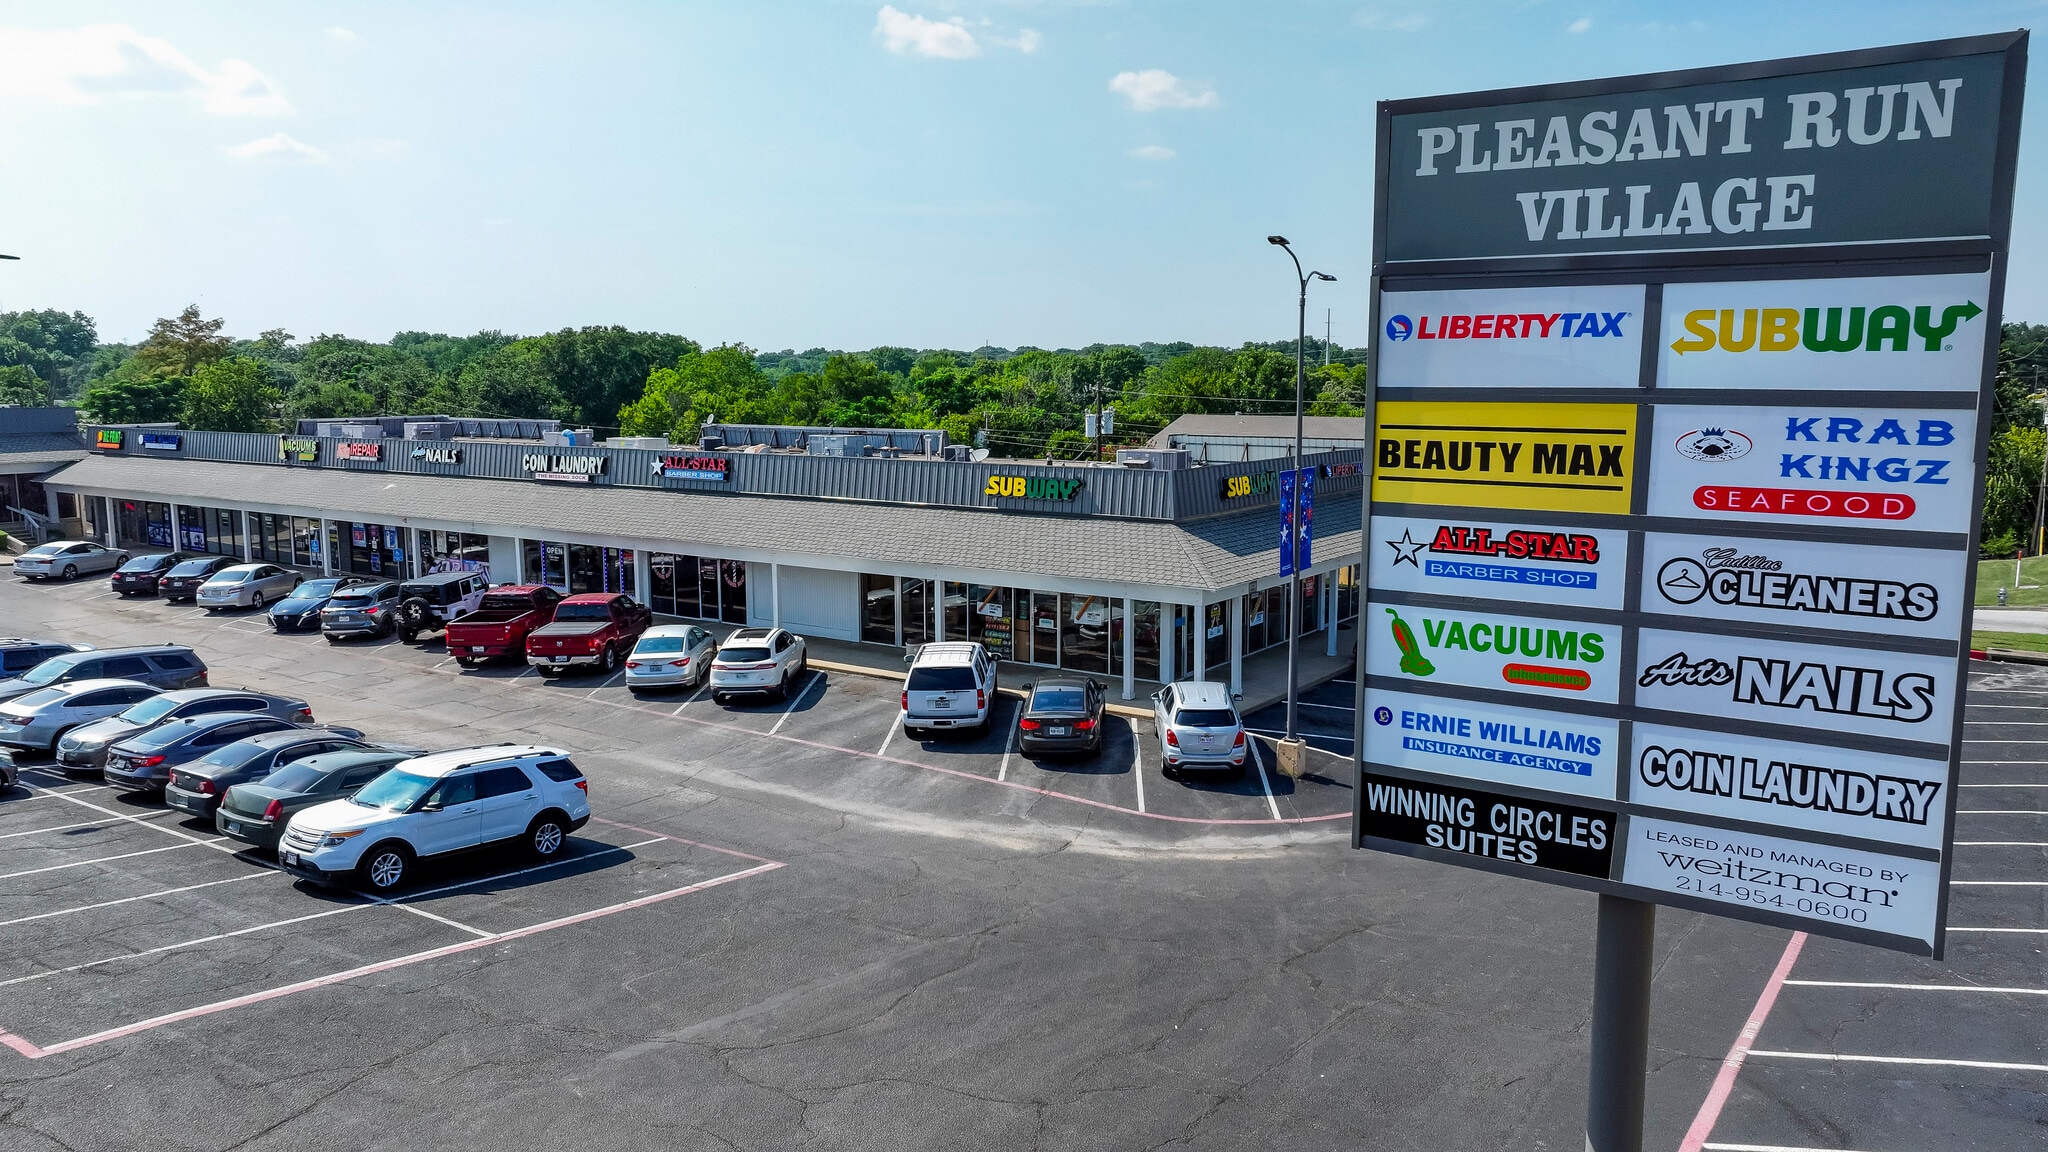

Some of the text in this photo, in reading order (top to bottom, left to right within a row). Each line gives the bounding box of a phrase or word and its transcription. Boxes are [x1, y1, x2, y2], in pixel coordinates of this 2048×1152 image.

[1415, 78, 1963, 177] PLEASANT RUN
[1516, 174, 1816, 241] VILLAGE
[1670, 299, 1983, 356] SUBWAY
[284, 439, 317, 452] VACUUMS
[1785, 416, 1955, 446] KRAB
[425, 449, 457, 463] NAILS
[522, 454, 604, 474] COIN LAUNDRY
[664, 456, 727, 471] ALL-STAR
[1378, 439, 1624, 477] BEAUTY MAX
[1779, 453, 1952, 485] KINGZ
[984, 475, 1080, 500] SUBWAY
[1227, 471, 1278, 498] SUBWAY
[1702, 489, 1905, 516] SEAFOOD
[546, 547, 563, 555] OPEN
[1429, 525, 1600, 564] ALL-STAR
[1703, 547, 1782, 571] Cadillac
[1430, 563, 1591, 586] BARBER SHOP
[1708, 569, 1938, 622] CLEANERS
[1422, 618, 1605, 663] VACUUMS
[1639, 651, 1935, 723] Arts NAILS
[1401, 710, 1602, 757] ERNIE WILLIAMS
[1408, 738, 1583, 774] INSURANCE AGENCY
[1640, 745, 1943, 826] COIN LAUNDRY
[1367, 782, 1607, 850] WINNING CIRCLES
[1425, 824, 1538, 865] SUITES
[1646, 829, 1909, 884] LEASED AND MANAGED BY
[1657, 851, 1893, 908] weitzman
[1675, 875, 1868, 923] 214-954-0600
